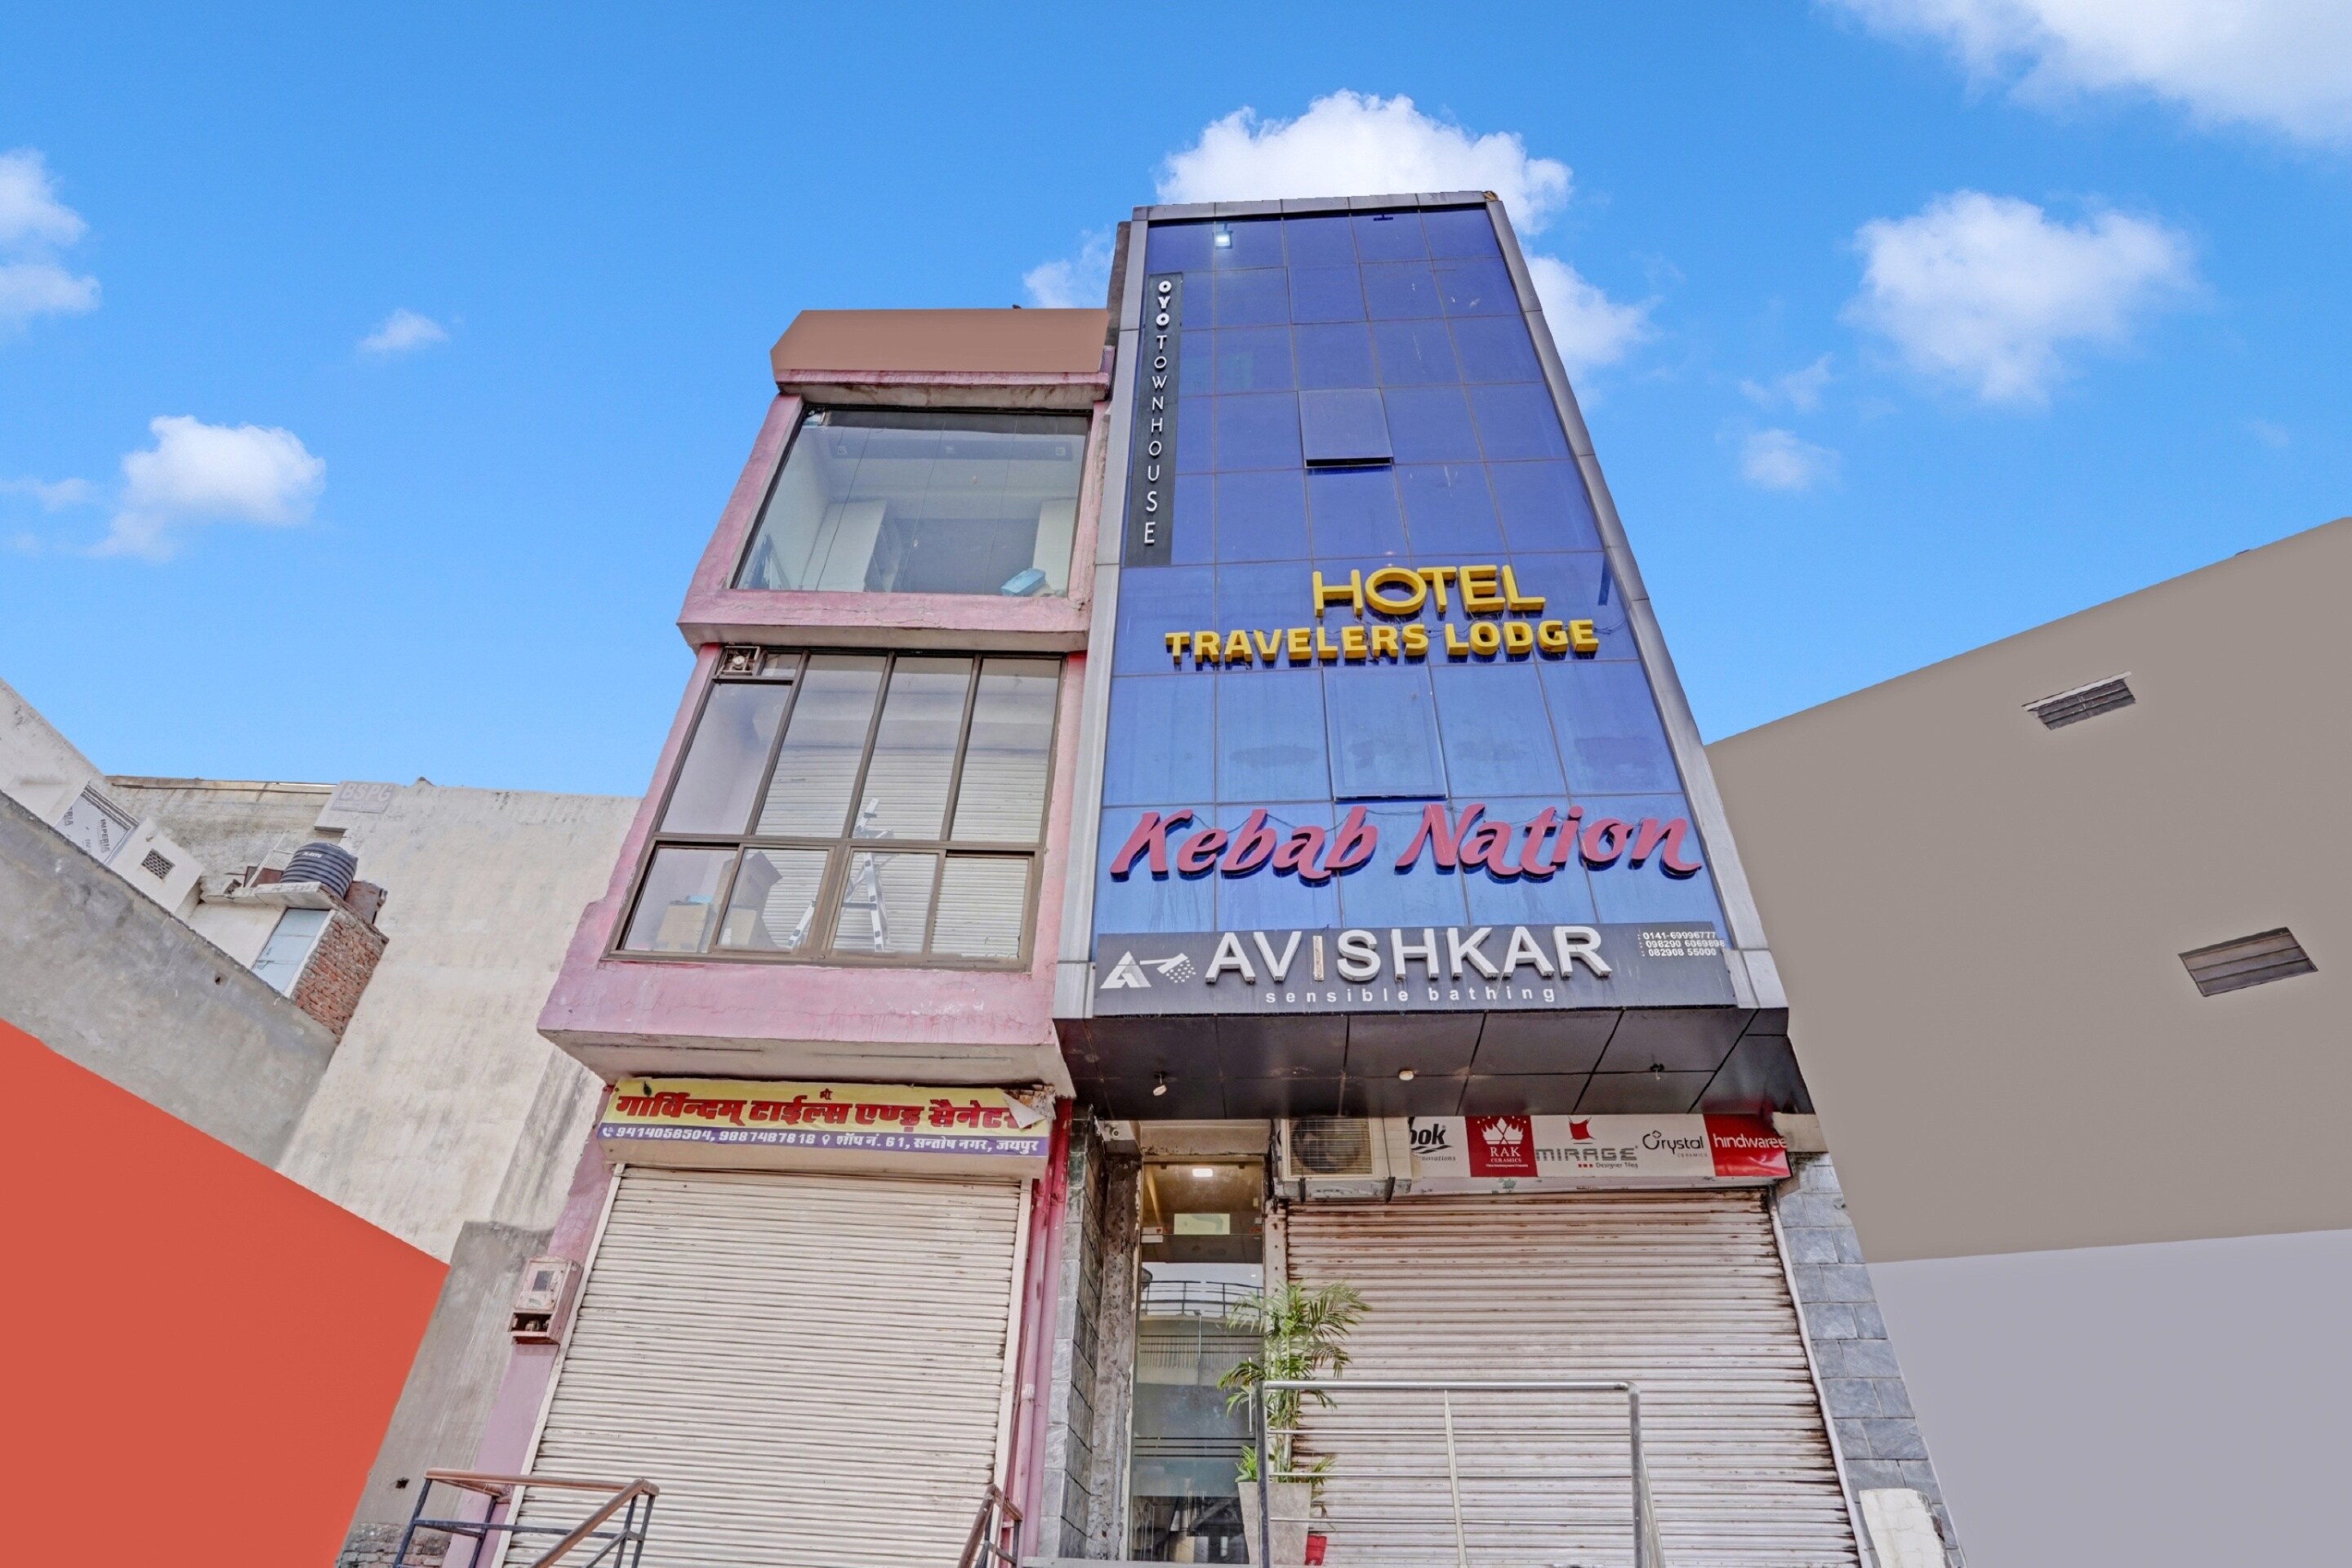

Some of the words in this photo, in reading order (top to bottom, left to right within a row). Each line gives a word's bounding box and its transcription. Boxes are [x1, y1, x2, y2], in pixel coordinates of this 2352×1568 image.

[1156, 280, 1172, 327] OYO
[1144, 335, 1168, 545] TOWNHOUSE
[1312, 564, 1545, 617] HOTEL
[1165, 621, 1430, 664] TRAVELERS
[1445, 619, 1600, 660] LODGE
[1109, 806, 1380, 884] Kebab
[1394, 803, 1703, 879] Nation
[1205, 925, 1613, 984] AVISHKAR
[1266, 986, 1409, 1003] sensible
[1428, 985, 1556, 1003] bathing
[1490, 1147, 1521, 1157] RAK
[1535, 1147, 1637, 1161] MIRAGE
[1642, 1129, 1704, 1155] Crystal
